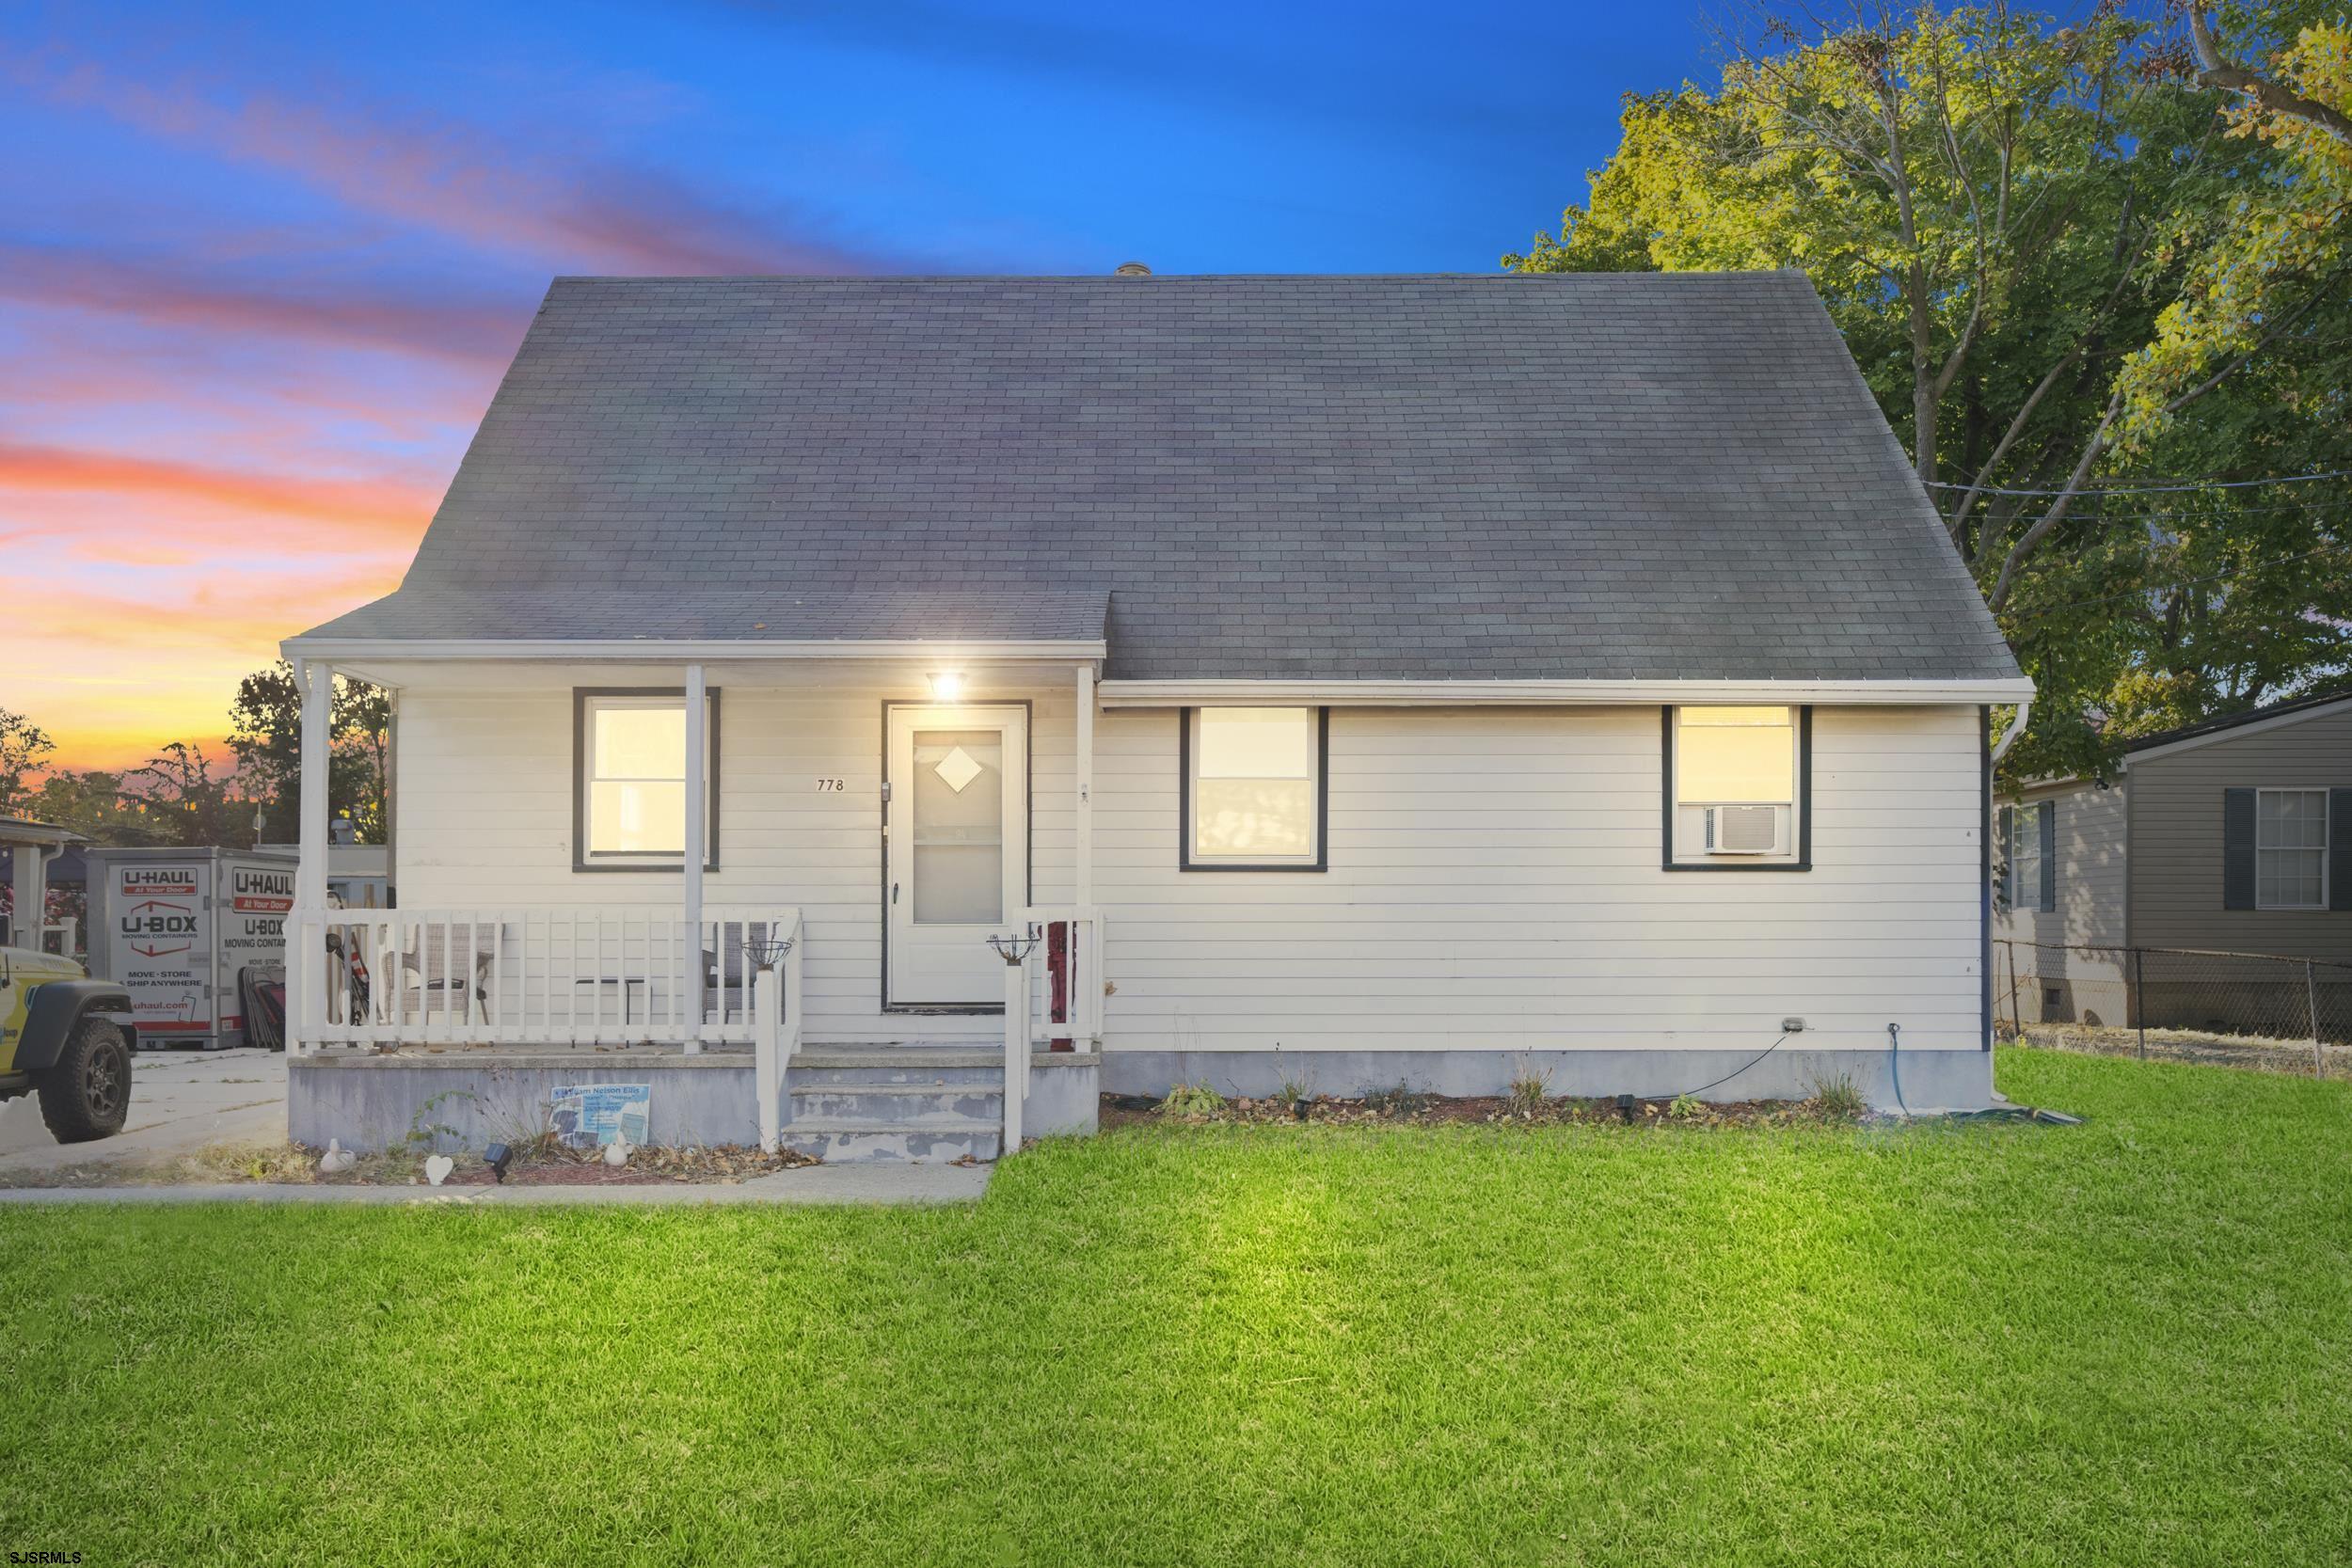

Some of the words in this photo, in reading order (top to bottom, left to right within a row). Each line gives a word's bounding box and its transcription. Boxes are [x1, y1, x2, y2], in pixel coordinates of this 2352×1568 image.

[818, 779, 844, 791] 778
[124, 871, 195, 884] U-HAUL
[235, 872, 293, 895] U-HAUL
[243, 899, 252, 908] At
[254, 899, 269, 909] Your
[271, 900, 288, 910] Door
[121, 916, 198, 933] U-BOX
[245, 919, 284, 935] U-BOX
[224, 939, 255, 948] MOVING
[134, 1001, 188, 1009] uhaul.com
[623, 1085, 640, 1094] Ellis
